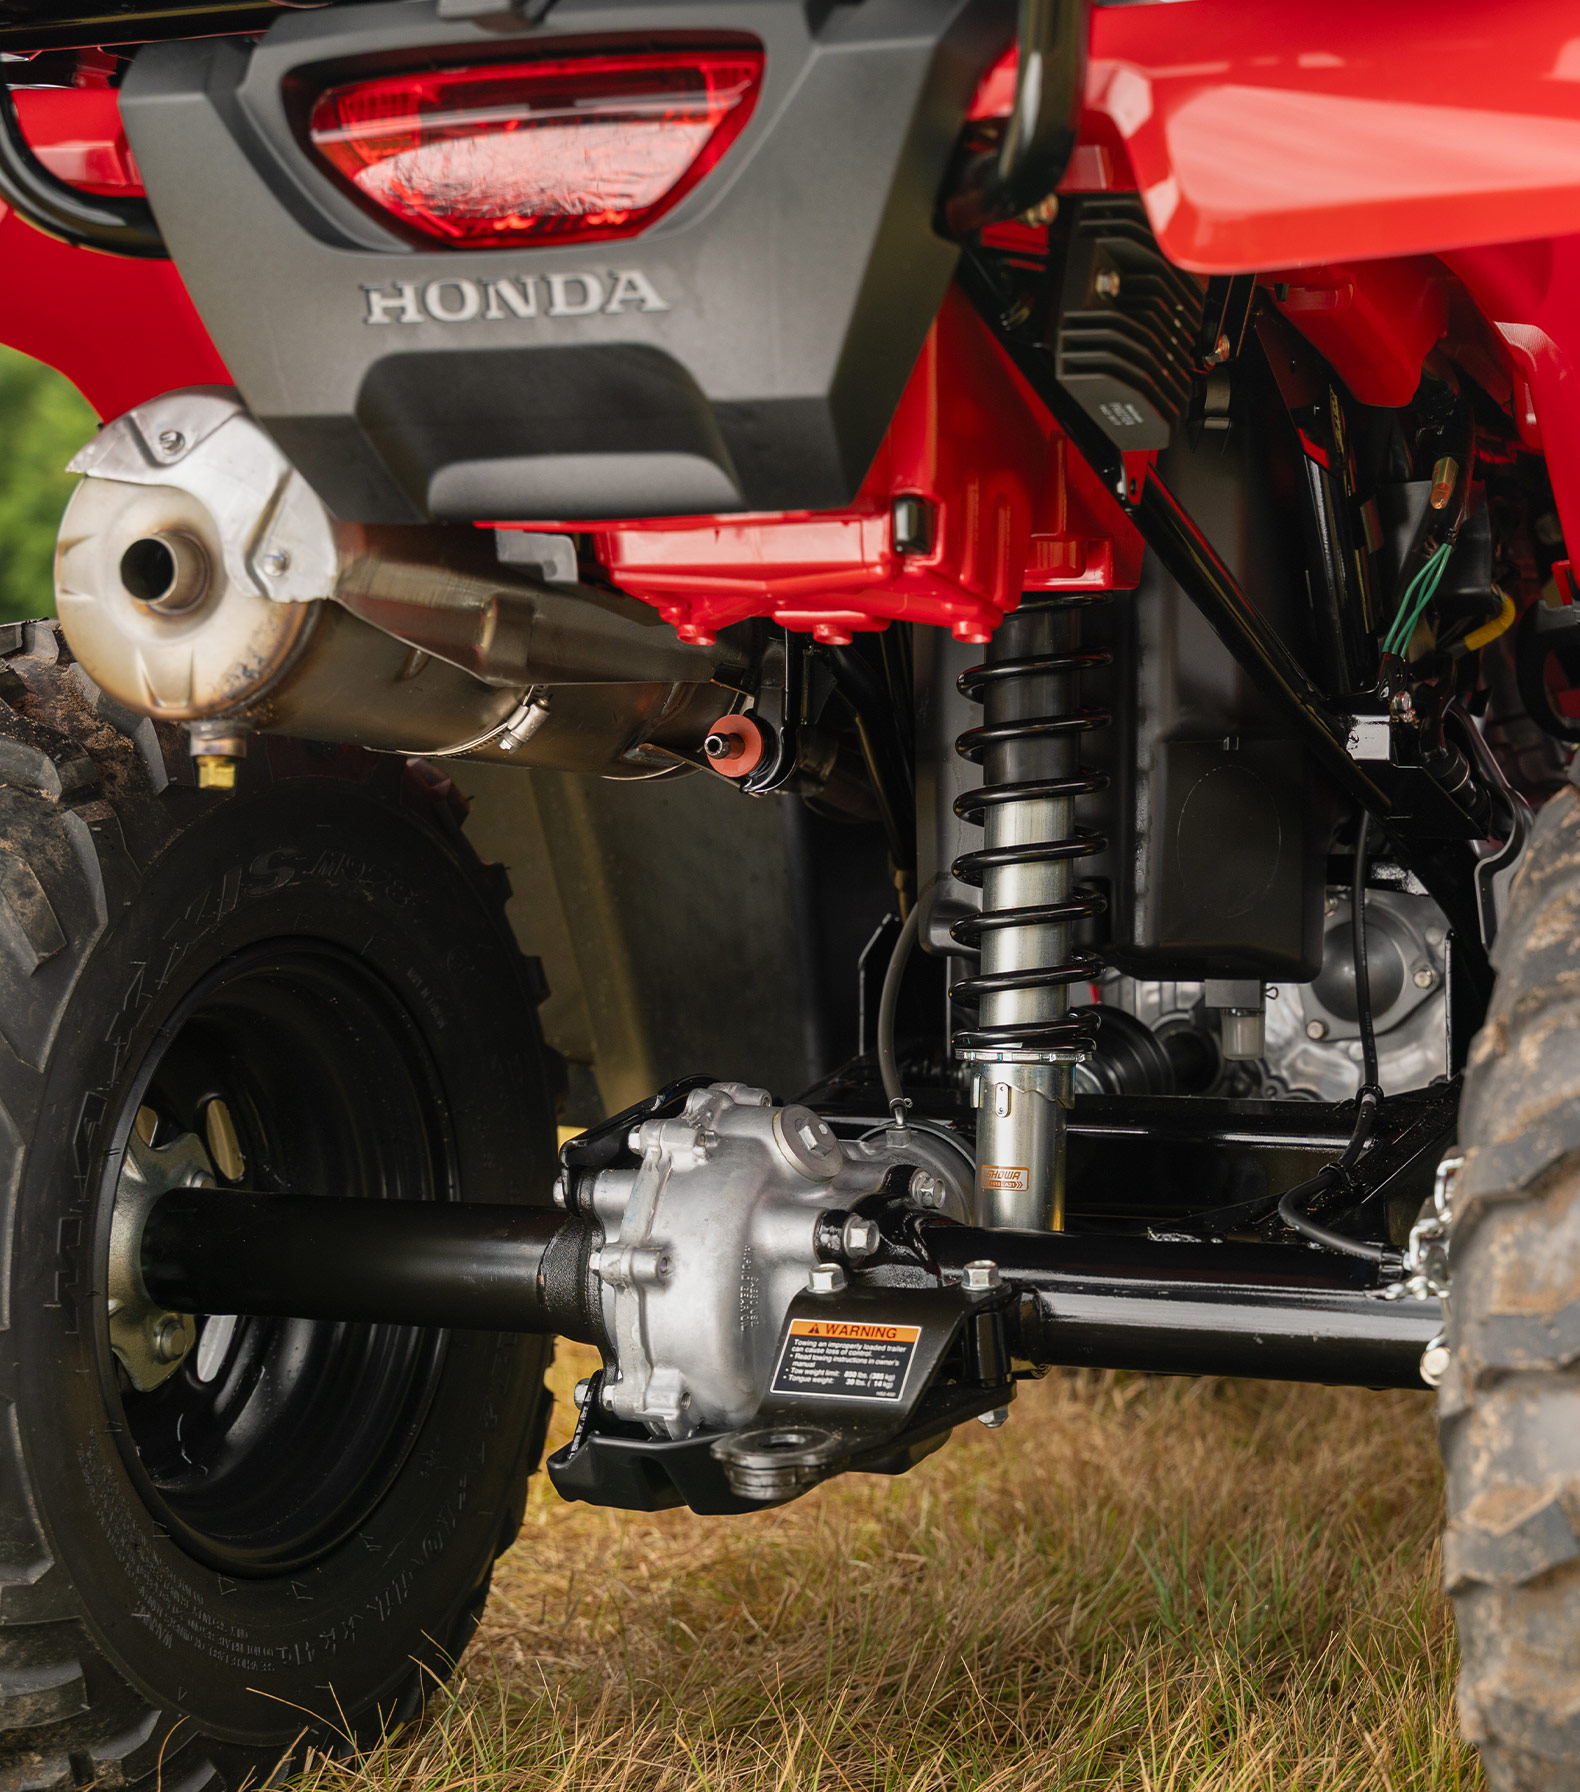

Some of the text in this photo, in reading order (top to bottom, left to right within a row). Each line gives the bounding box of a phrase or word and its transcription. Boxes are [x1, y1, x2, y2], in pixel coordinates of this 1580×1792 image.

[361, 268, 671, 326] HONDA
[986, 1170, 1021, 1180] SHOWA
[826, 1323, 897, 1338] WARNING
[795, 1339, 817, 1347] Towing
[828, 1341, 862, 1351] improperly
[863, 1343, 886, 1352] loaded
[887, 1345, 907, 1353] trailer
[849, 1349, 873, 1357] control.
[812, 1354, 832, 1363] towing
[833, 1355, 868, 1364] instructions
[876, 1358, 899, 1367] owner's
[791, 1367, 804, 1375] Tow
[804, 1368, 825, 1377] weight
[788, 1374, 811, 1383] Tongue
